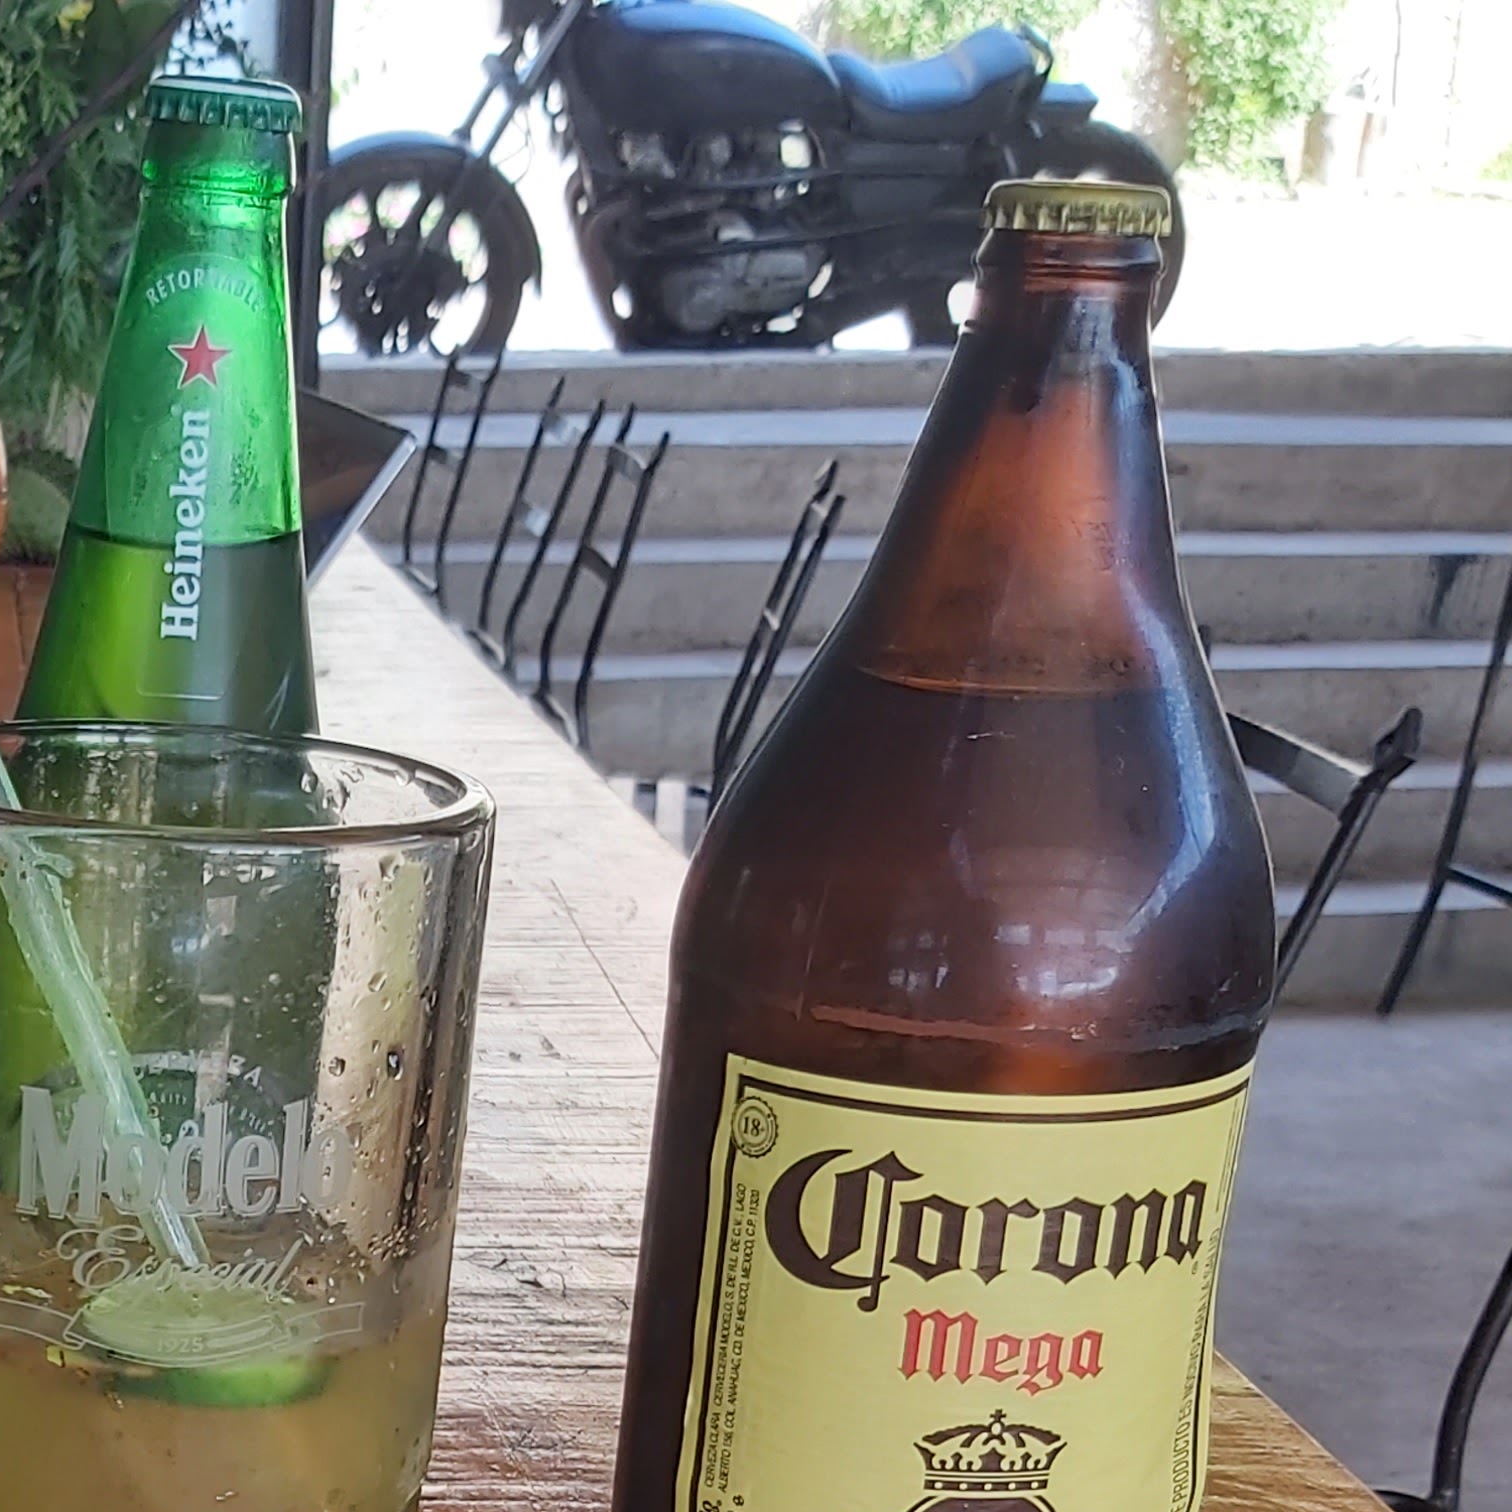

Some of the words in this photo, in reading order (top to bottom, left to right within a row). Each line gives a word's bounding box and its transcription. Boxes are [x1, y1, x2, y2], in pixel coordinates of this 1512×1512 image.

[160, 409, 211, 641] Heineken
[15, 1085, 351, 1227] Modelo
[764, 1148, 1208, 1313] Corona
[897, 1308, 1105, 1396] Mega
[1172, 1421, 1191, 1503] PRODUCTO
